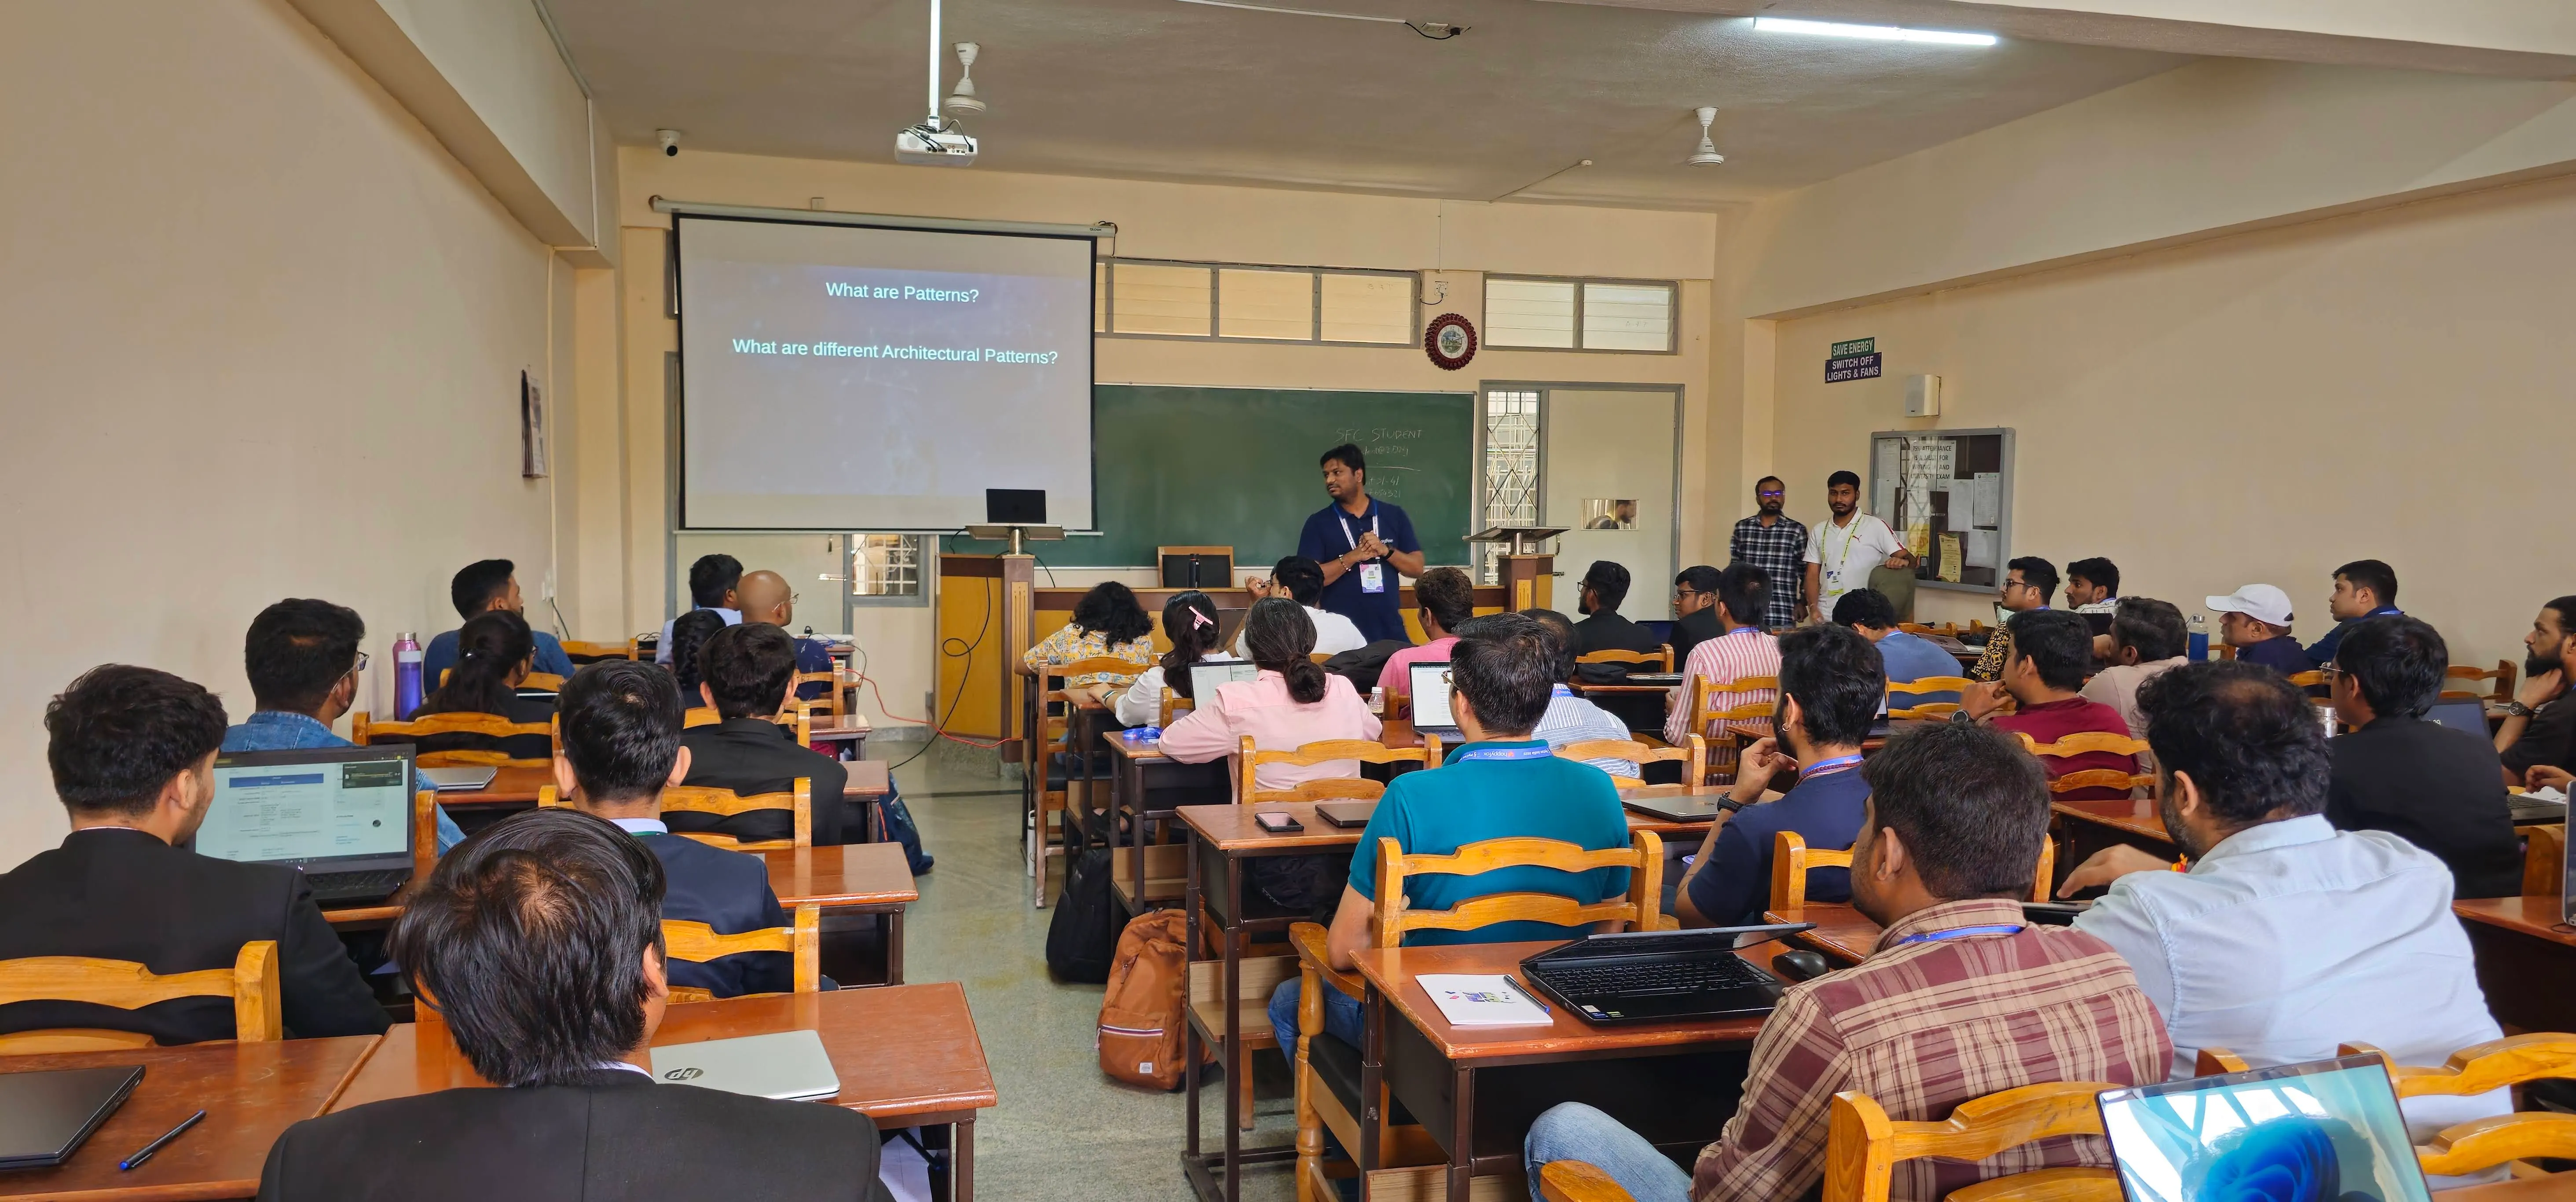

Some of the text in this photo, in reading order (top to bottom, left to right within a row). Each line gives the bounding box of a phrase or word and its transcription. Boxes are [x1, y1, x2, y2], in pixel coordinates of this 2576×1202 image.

[826, 282, 979, 302] What are Patterns?
[732, 338, 1057, 365] What are different Architectural Patterns?
[1833, 339, 1873, 356] SAVE ENERGY
[1832, 355, 1873, 370] SWITCH OFF
[1827, 366, 1879, 381] LIGHTS & FANS
[1334, 428, 1422, 443] SFC STUDENT
[664, 1067, 704, 1081] hp
